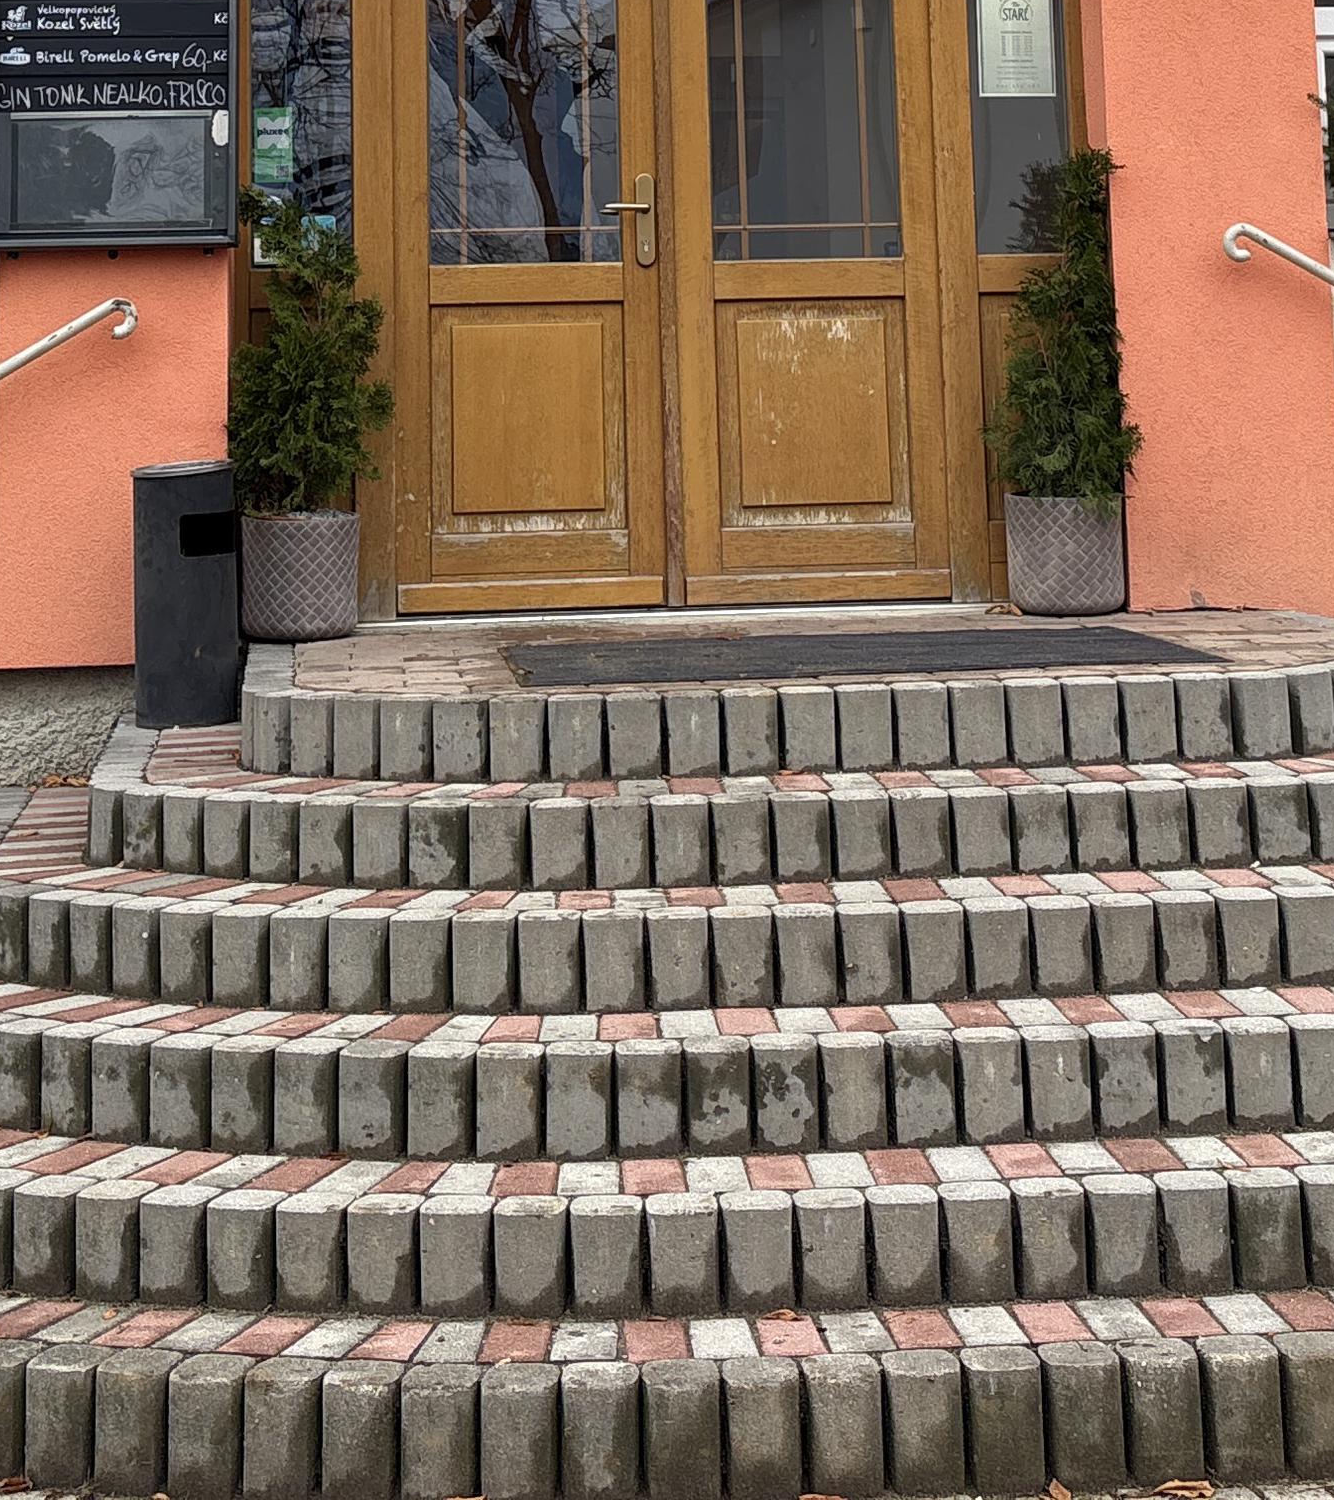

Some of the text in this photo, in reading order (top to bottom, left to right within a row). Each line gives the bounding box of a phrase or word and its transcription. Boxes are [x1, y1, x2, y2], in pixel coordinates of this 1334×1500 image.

[37, 4, 116, 19] Velkopopovický
[37, 12, 228, 35] Kozel Světlý Kč
[36, 49, 74, 64] Birell
[80, 49, 131, 63] Pomelo
[133, 49, 143, 63] &
[145, 49, 180, 69] Grep
[213, 49, 228, 61] Kč
